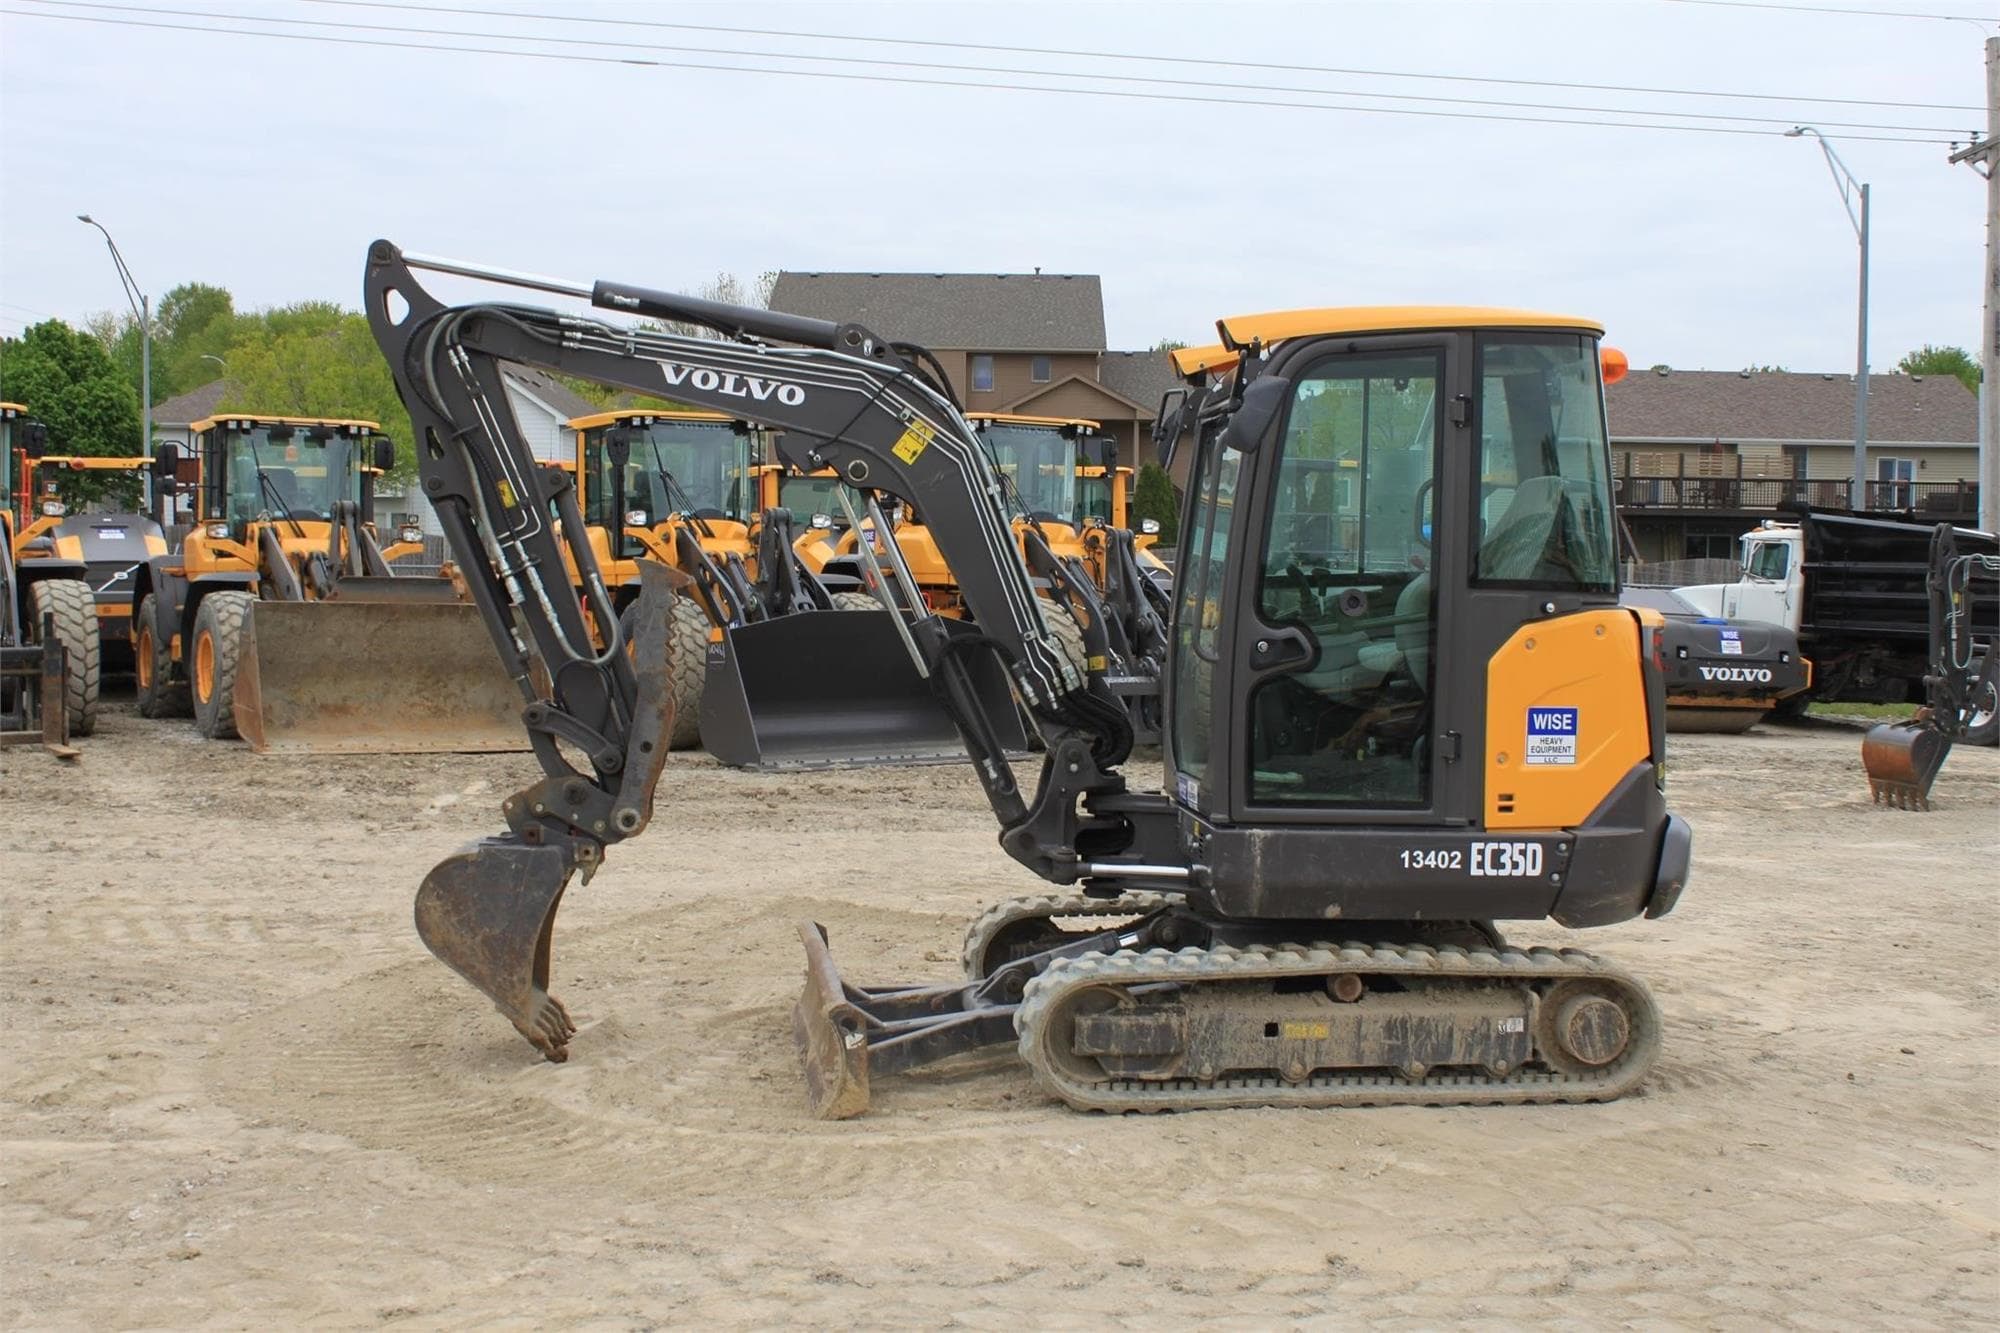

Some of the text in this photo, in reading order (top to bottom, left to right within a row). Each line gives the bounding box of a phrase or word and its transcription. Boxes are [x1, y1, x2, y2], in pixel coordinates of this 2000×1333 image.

[657, 361, 806, 406] VOLVO
[1699, 666, 1772, 683] VOLVO
[1532, 713, 1573, 730] WISE
[1530, 745, 1573, 754] EQUIPMENT
[1539, 737, 1564, 745] HEAVY
[1400, 842, 1543, 876] 13402 EC35D
